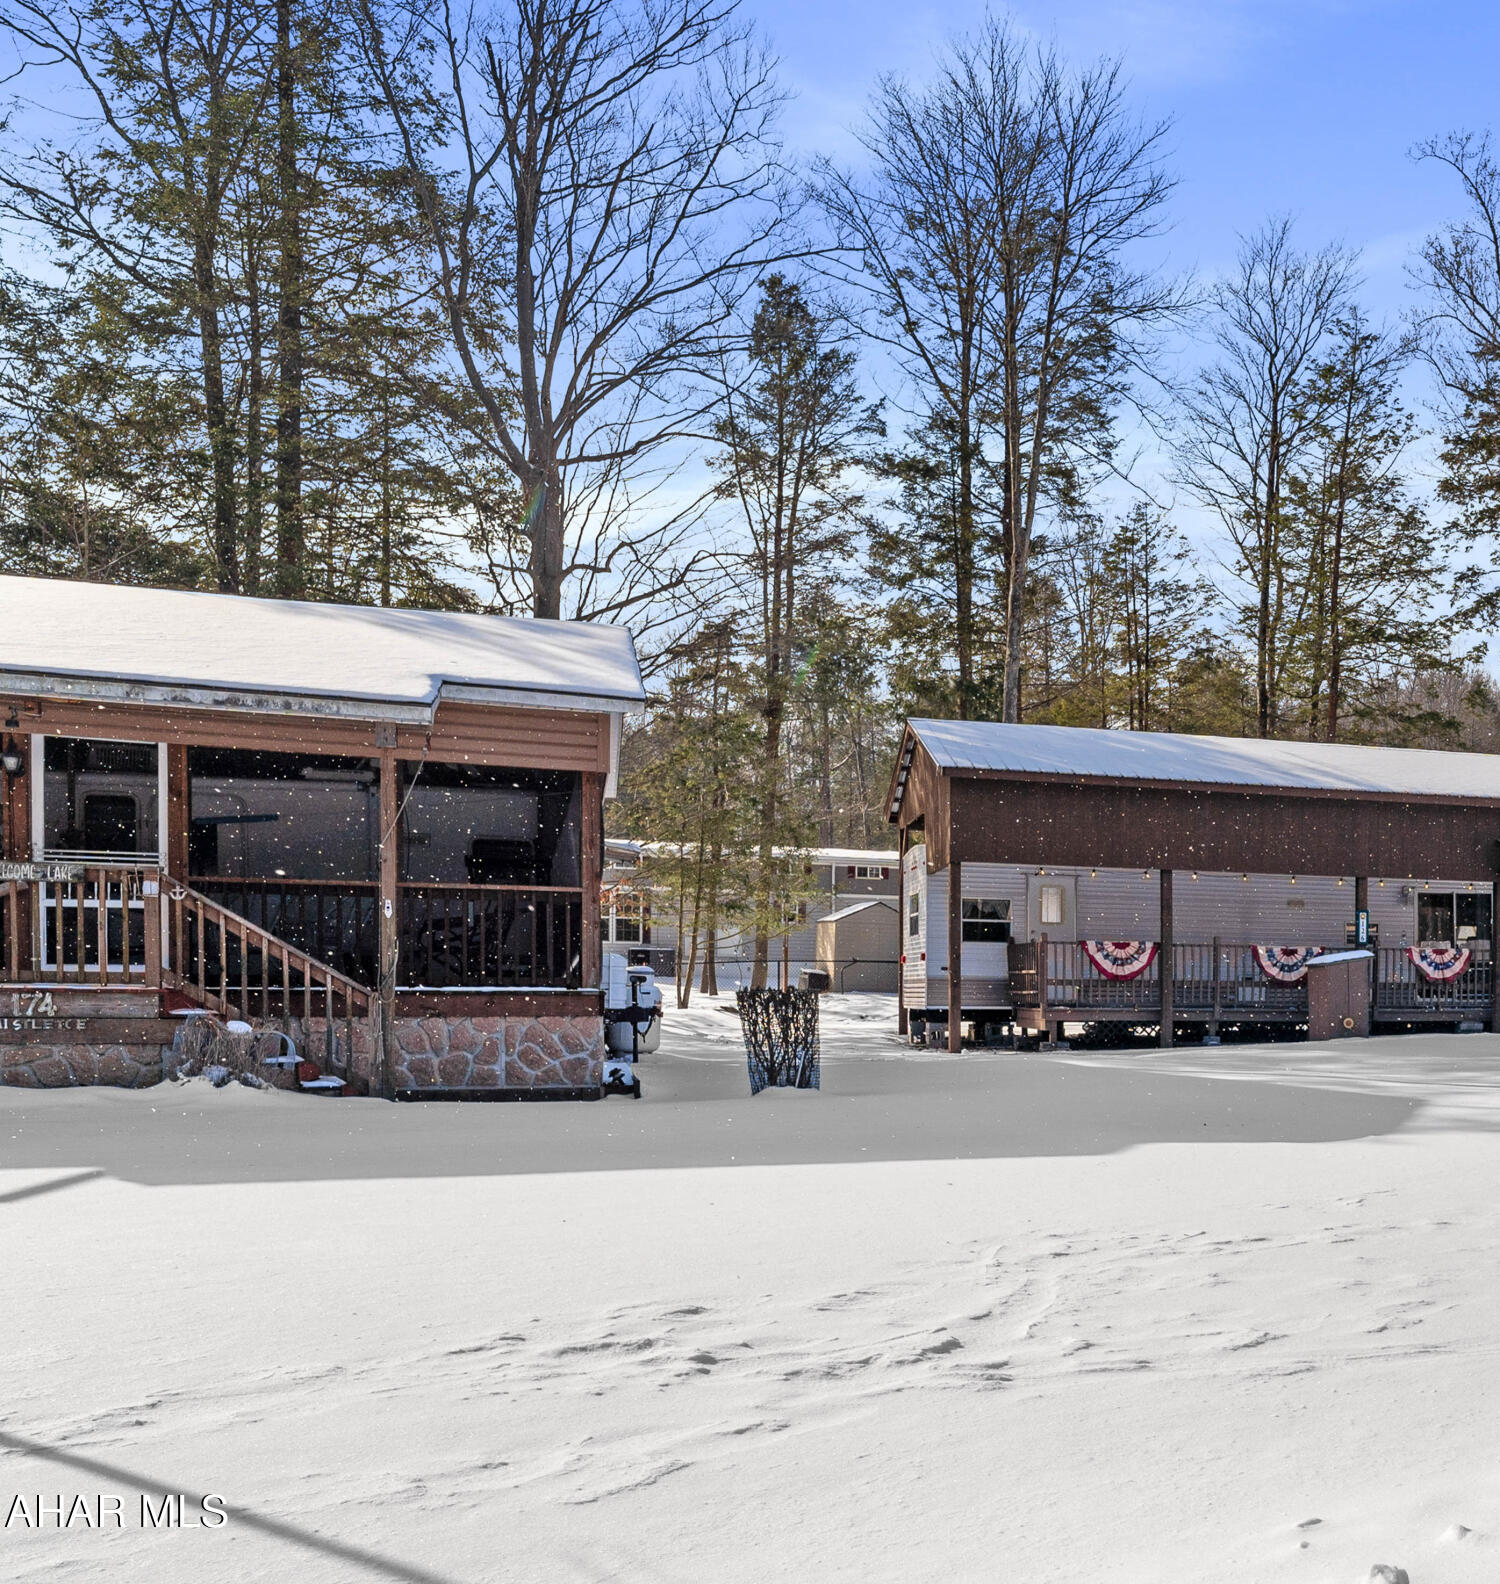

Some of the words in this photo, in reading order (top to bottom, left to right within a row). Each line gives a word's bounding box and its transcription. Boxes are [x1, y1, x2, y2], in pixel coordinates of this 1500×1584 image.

[0, 864, 36, 880] LCOME
[47, 864, 73, 881] LAKE
[12, 992, 55, 1016] 174
[0, 1018, 87, 1031] ISTLETE
